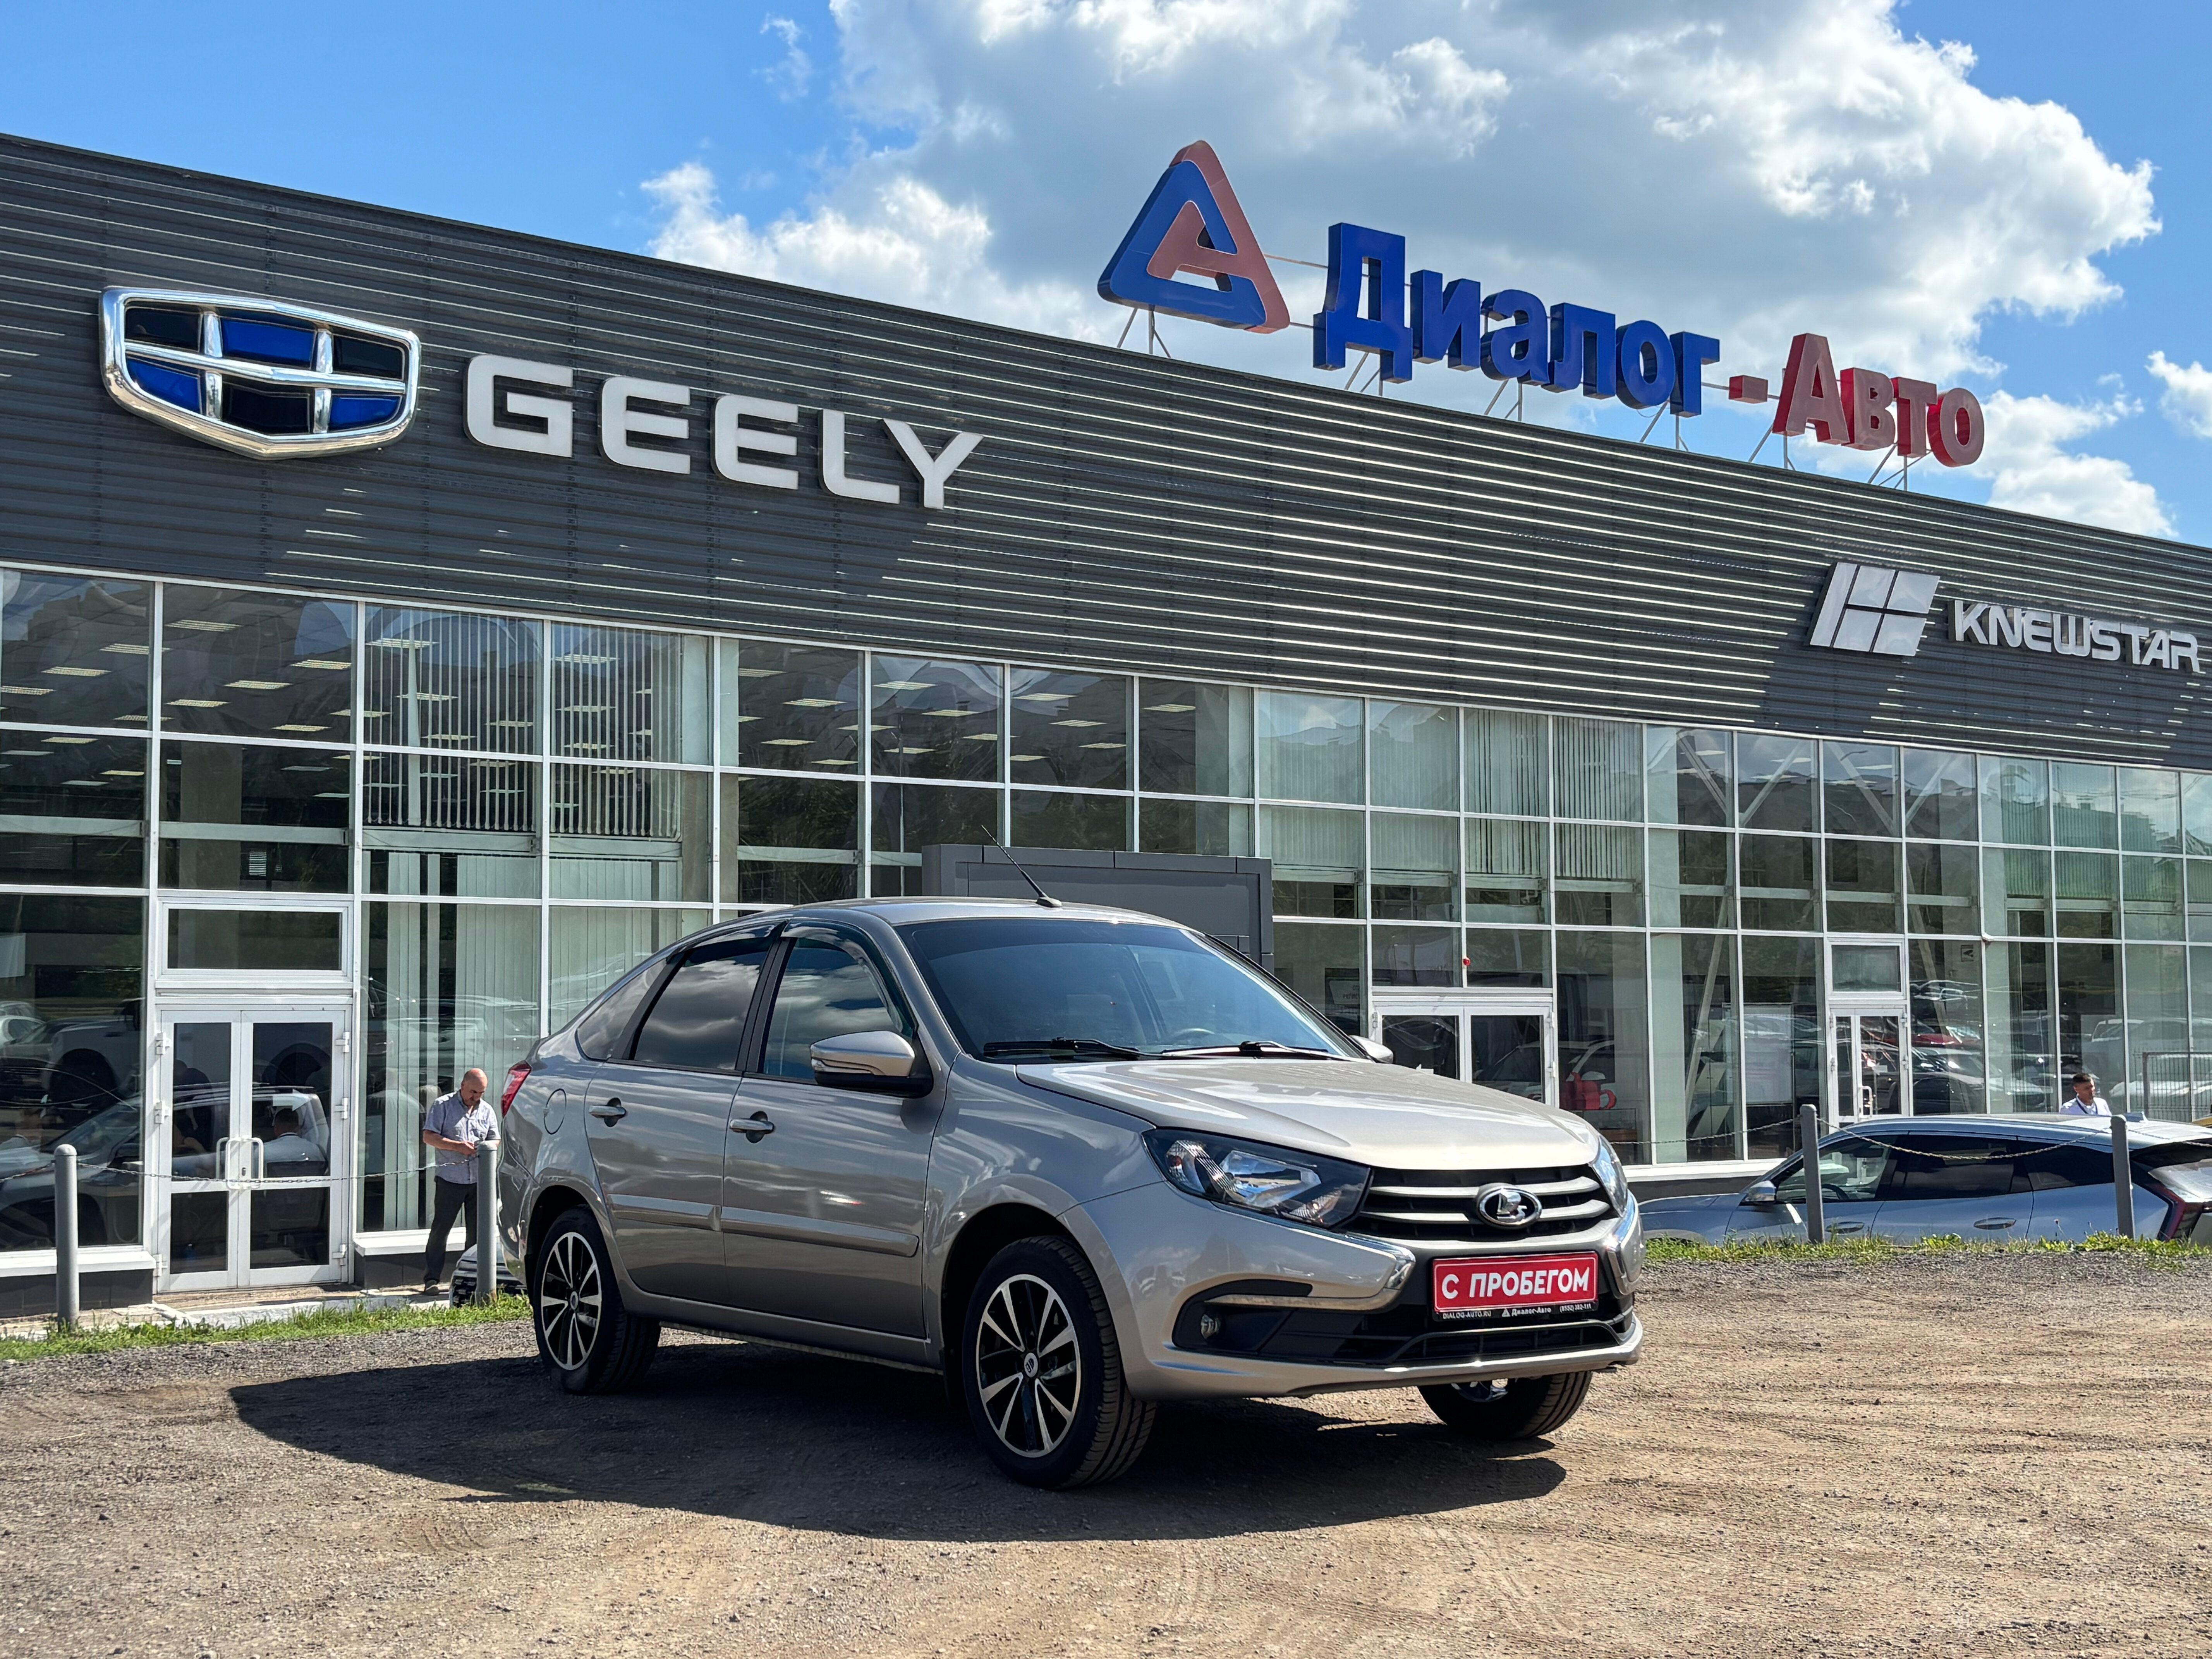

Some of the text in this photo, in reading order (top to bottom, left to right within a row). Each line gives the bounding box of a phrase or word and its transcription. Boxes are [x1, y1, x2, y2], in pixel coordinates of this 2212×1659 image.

[1313, 222, 1985, 467] Диалог-Авто
[465, 354, 984, 510] GEELY
[1954, 600, 2200, 673] KNEWSTAR
[1442, 1267, 1590, 1299] С ПРОБЕГОМ
